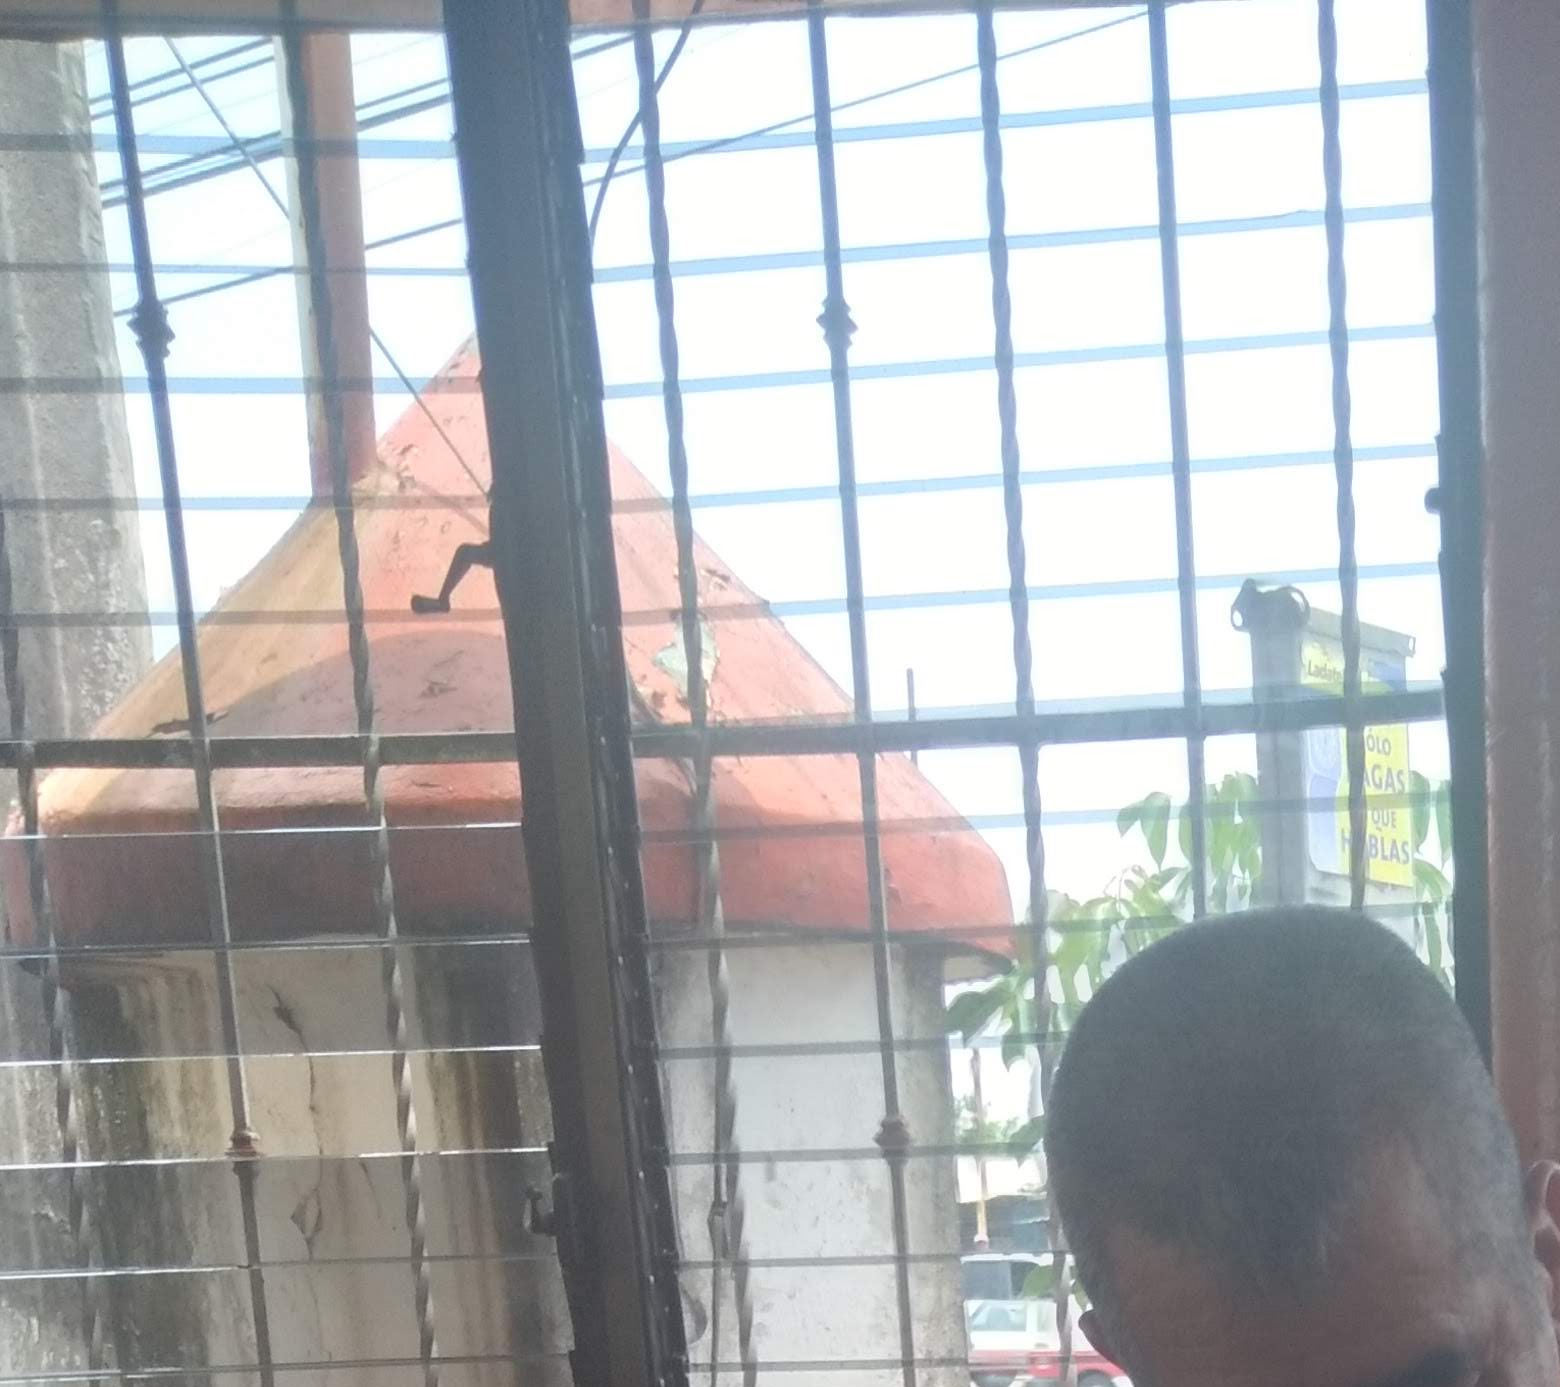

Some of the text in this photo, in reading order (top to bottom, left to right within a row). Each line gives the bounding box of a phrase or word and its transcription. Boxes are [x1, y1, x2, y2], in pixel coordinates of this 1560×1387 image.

[1308, 659, 1343, 682] Ladat
[1366, 727, 1392, 757] ÓLO
[1363, 763, 1405, 794] AGAS
[1371, 808, 1397, 832] QUE
[1341, 827, 1410, 865] HBLAS
